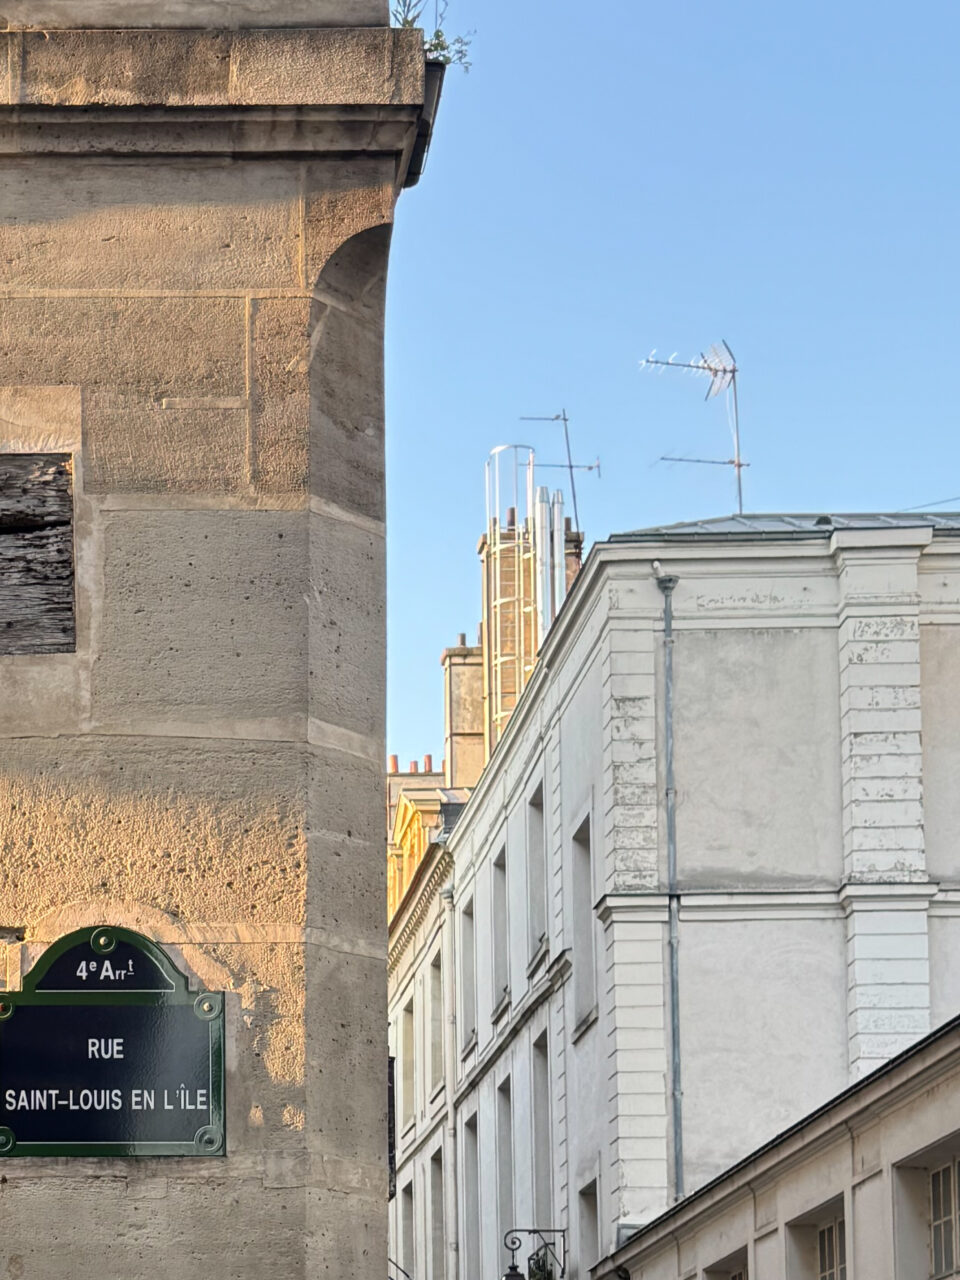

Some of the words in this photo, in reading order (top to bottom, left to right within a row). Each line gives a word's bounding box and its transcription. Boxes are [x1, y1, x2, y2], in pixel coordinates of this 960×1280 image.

[87, 1038, 125, 1059] RUE
[4, 1088, 123, 1111] SAINT-LOUIS
[130, 1088, 156, 1111] EN
